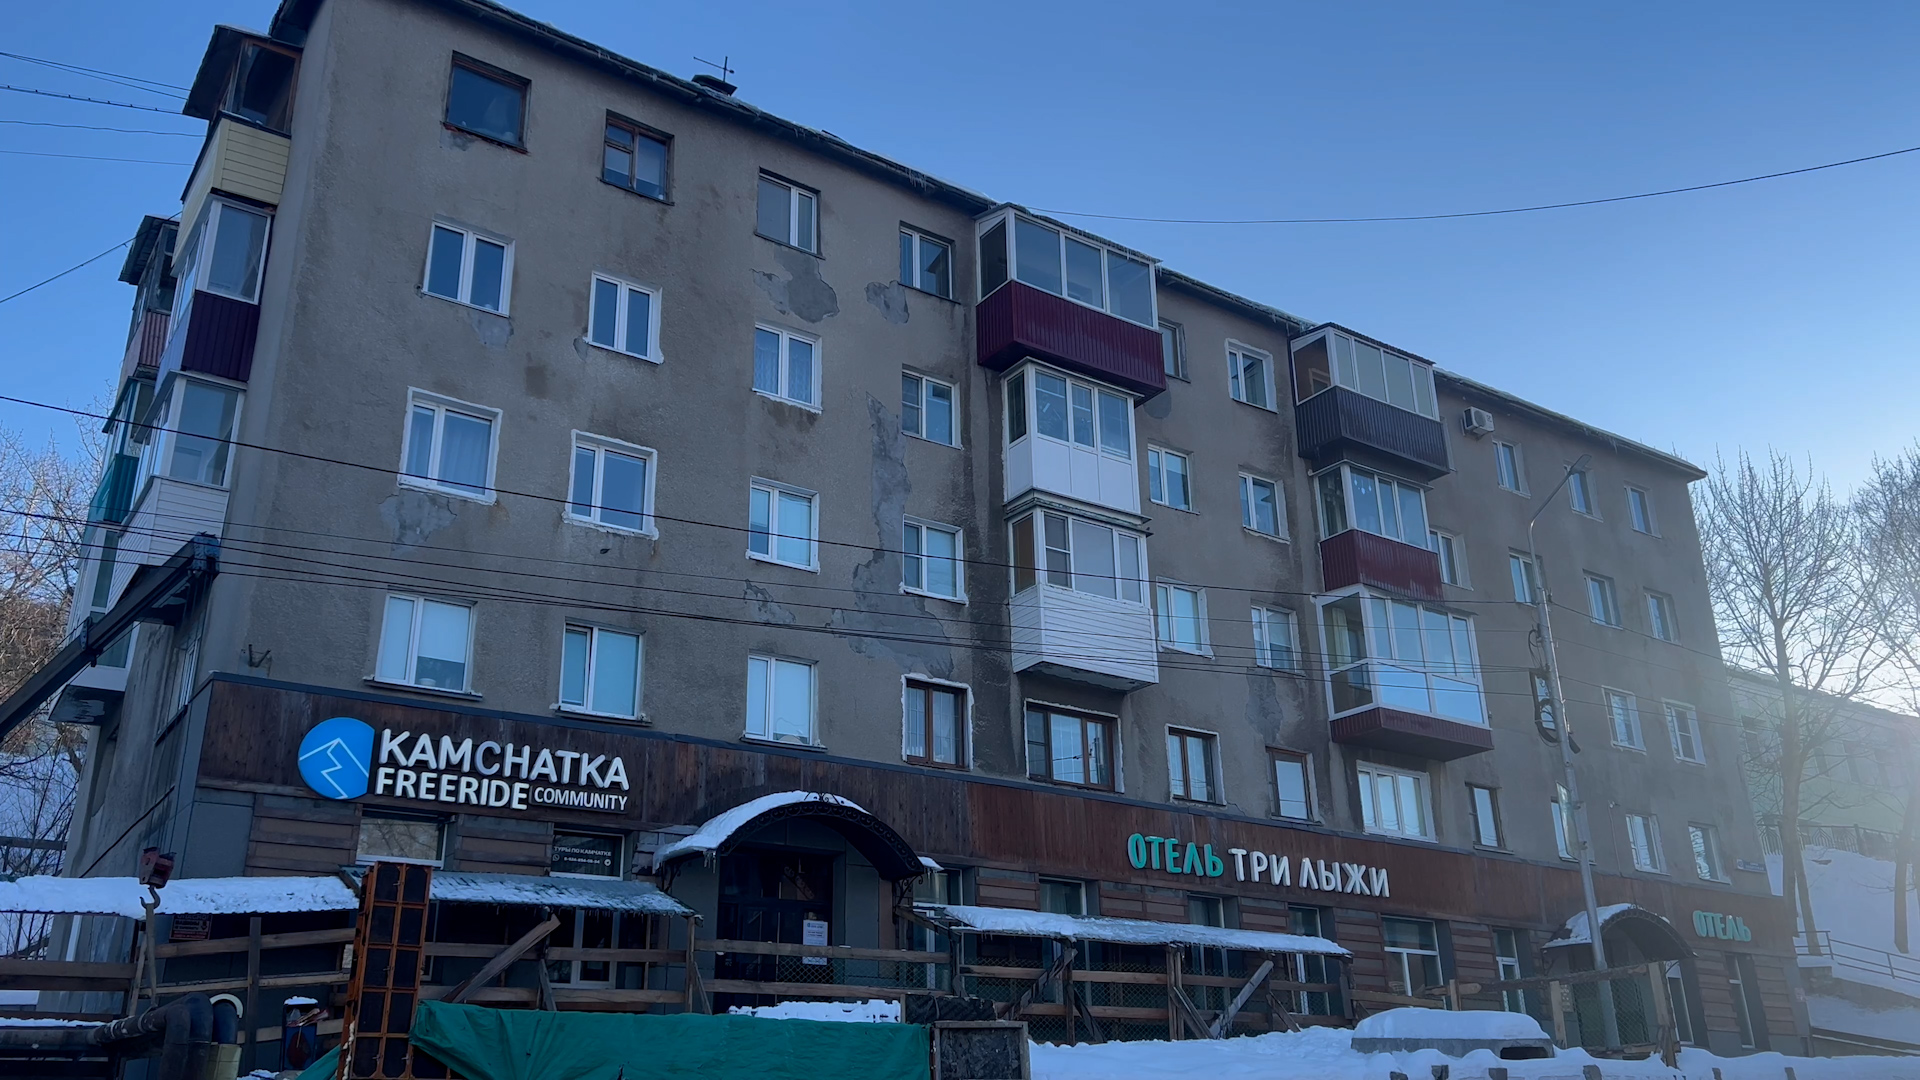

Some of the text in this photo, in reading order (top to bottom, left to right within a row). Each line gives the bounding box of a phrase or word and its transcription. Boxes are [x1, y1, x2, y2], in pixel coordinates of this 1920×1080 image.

[378, 728, 630, 791] KAMCHATKA
[375, 767, 629, 811] FREERIDE COMMUNITY
[1127, 833, 1390, 898] ОТЕЛЬ ТРИ ЛЫЖИ
[1692, 910, 1752, 942] ОТЕЛЬ
